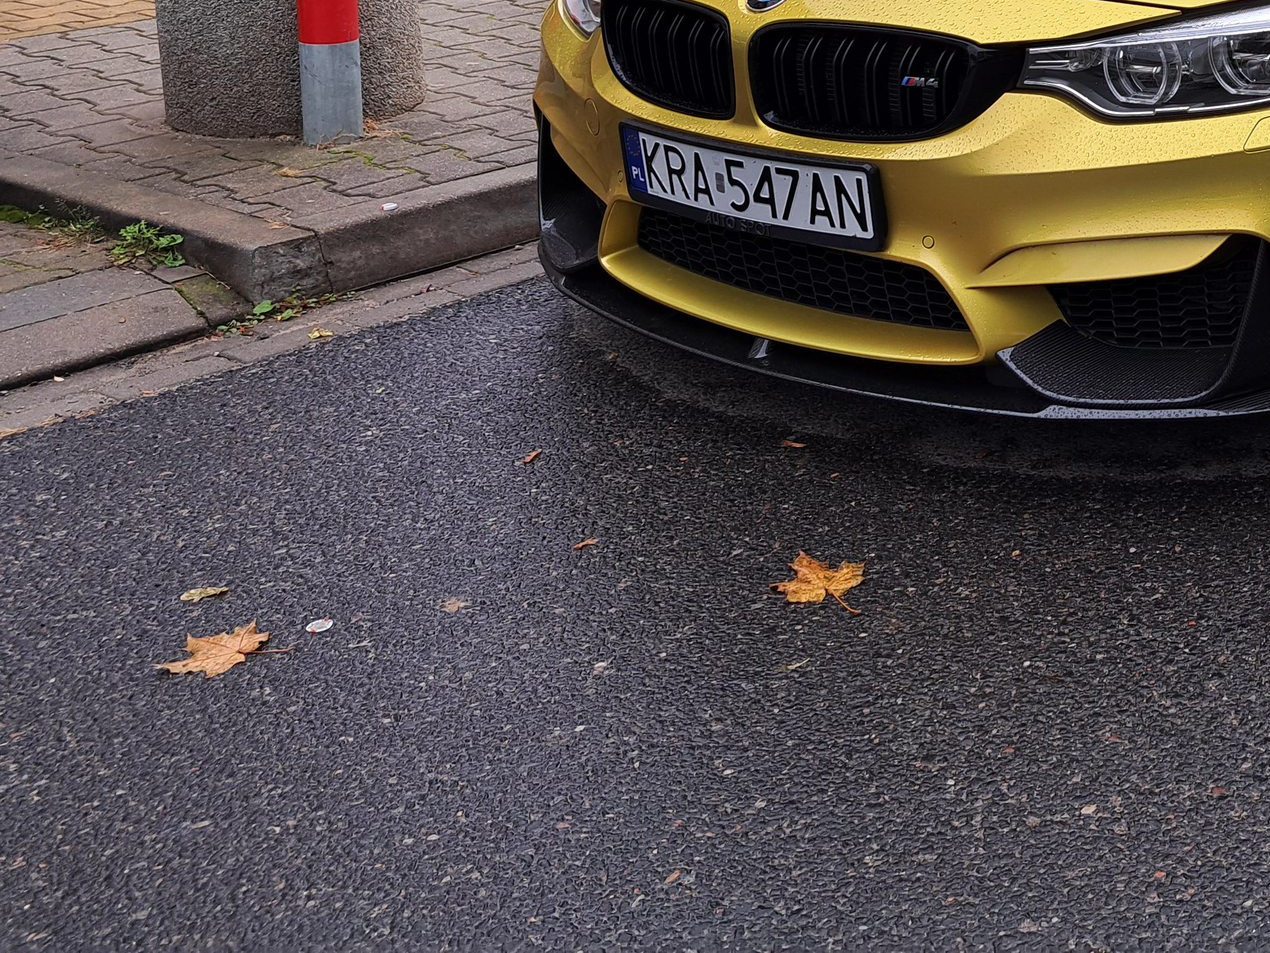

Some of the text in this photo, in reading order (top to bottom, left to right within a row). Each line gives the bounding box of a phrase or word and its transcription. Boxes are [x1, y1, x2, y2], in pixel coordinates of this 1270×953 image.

[632, 165, 645, 182] PL
[642, 137, 869, 233] KRA 547AN
[705, 211, 772, 237] AUTO SPOT
